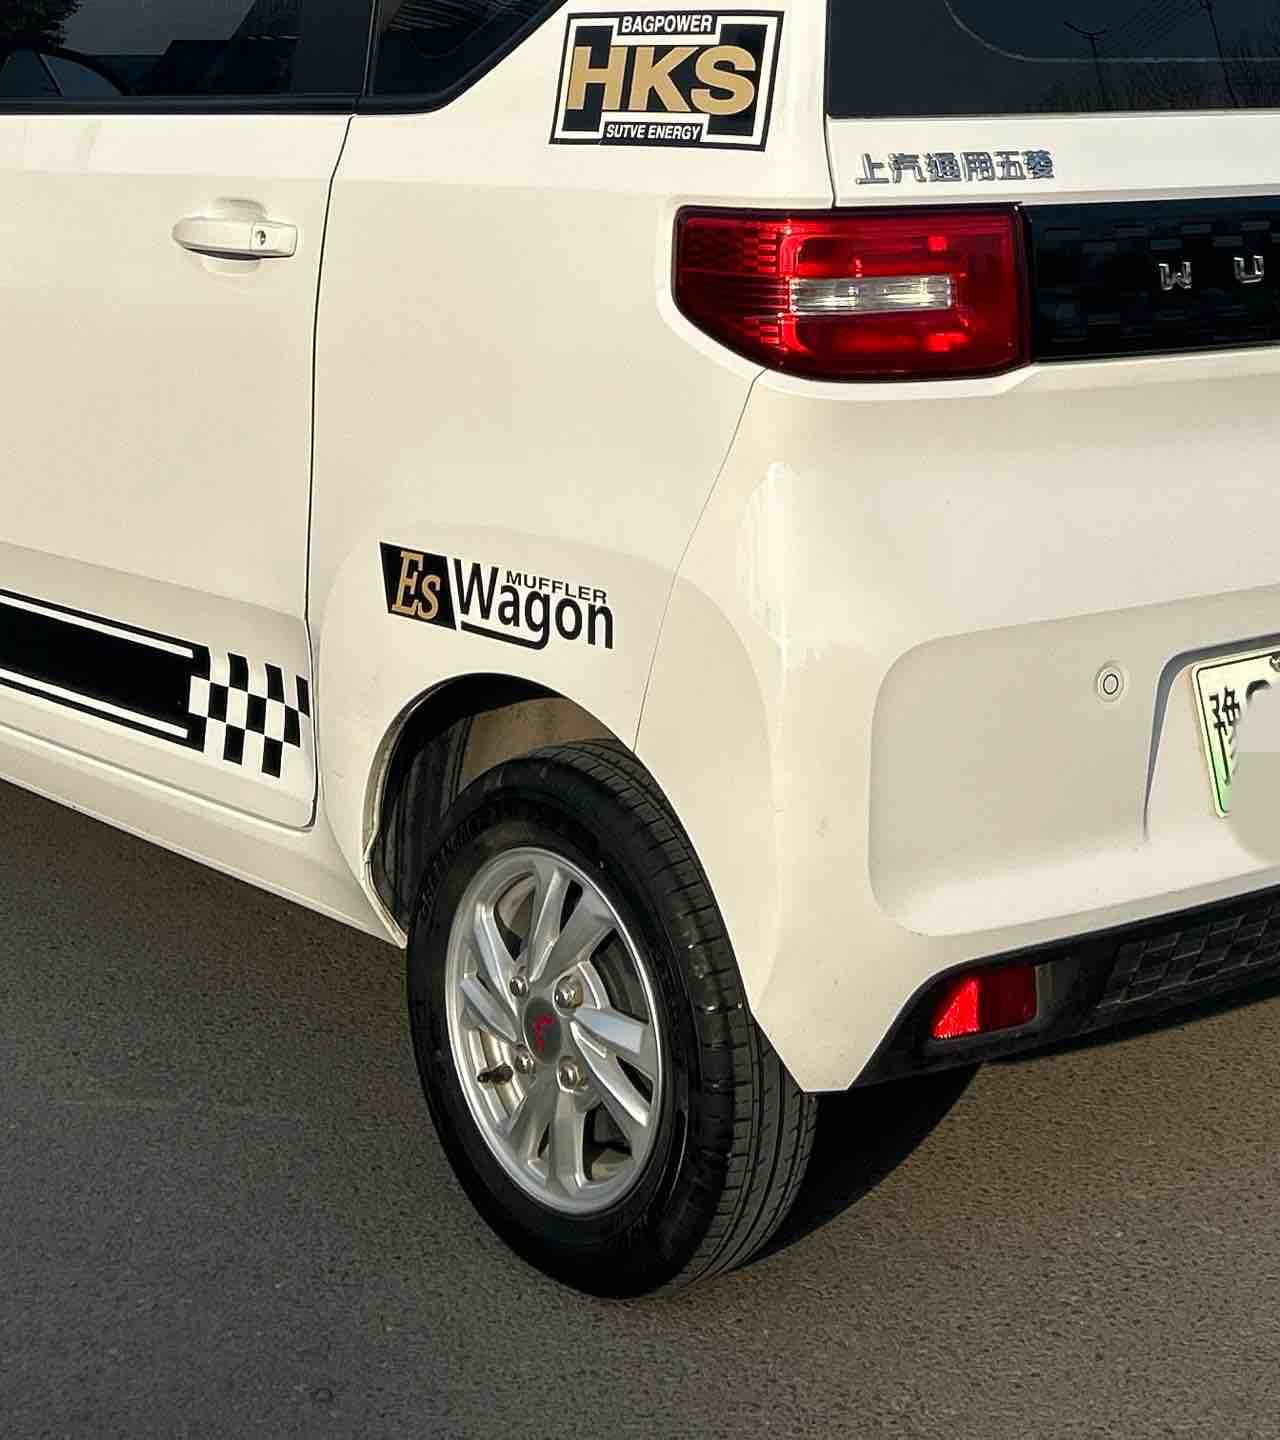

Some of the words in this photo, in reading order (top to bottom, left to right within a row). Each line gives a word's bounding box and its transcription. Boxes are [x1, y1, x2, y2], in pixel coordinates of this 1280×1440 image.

[621, 15, 713, 33] BAGPOWER
[567, 45, 756, 115] HKS
[606, 123, 646, 139] SUTVE
[648, 125, 701, 141] ENERGY
[855, 149, 1054, 184] 上汽通用五菱
[506, 570, 608, 604] MUFFLER
[453, 558, 614, 651] Wagon
